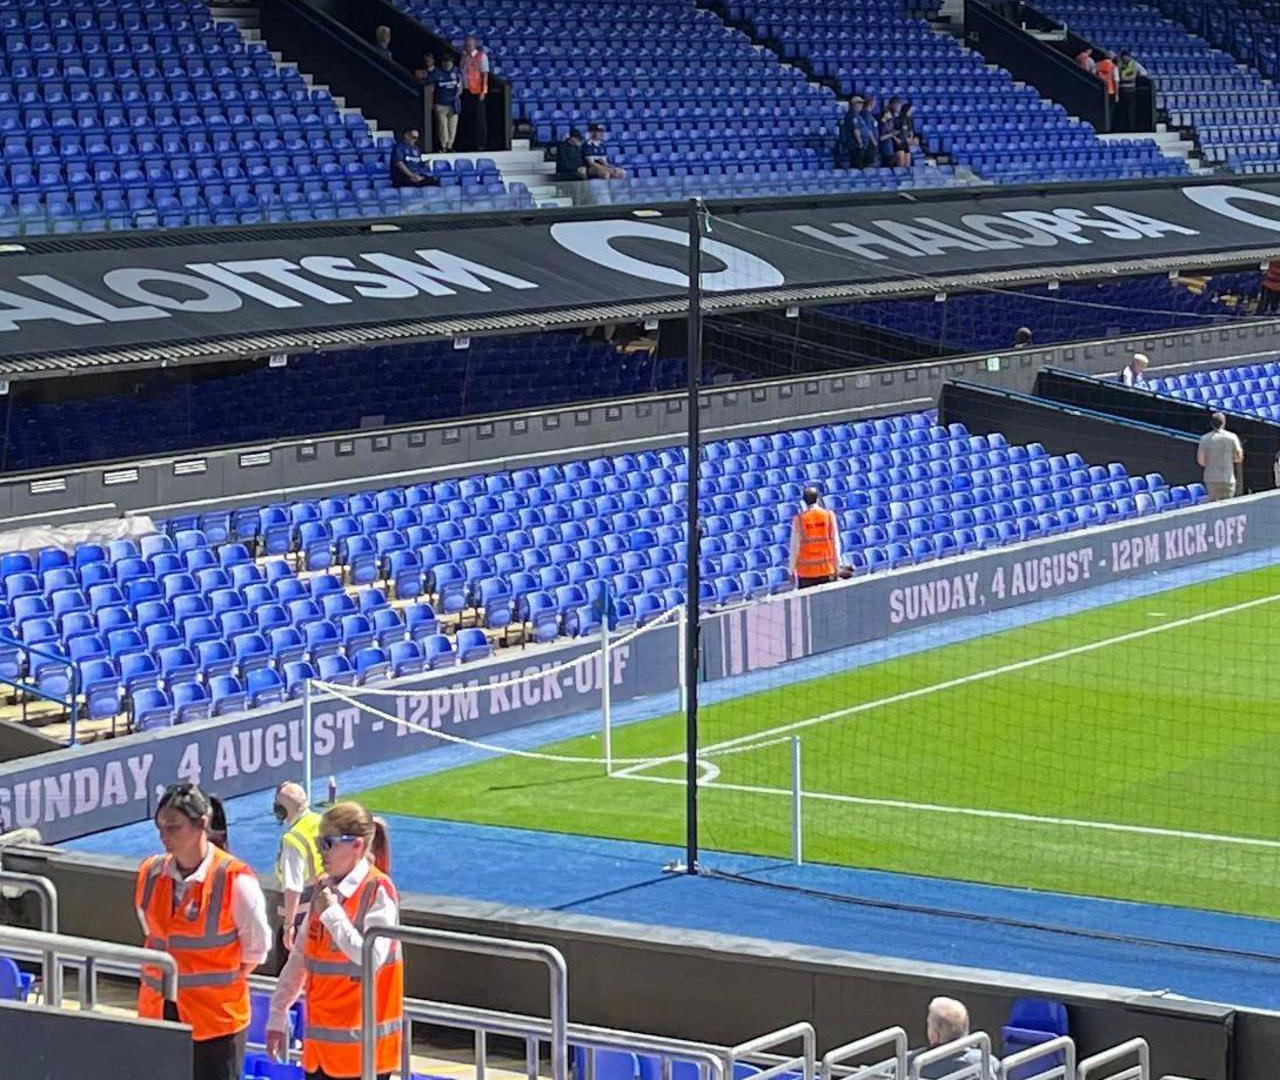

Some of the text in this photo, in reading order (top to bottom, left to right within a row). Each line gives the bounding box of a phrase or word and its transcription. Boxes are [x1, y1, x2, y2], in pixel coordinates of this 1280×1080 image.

[793, 204, 1200, 262] HALOPSA
[890, 572, 986, 623] SUNDAY,
[992, 566, 1006, 598] 4
[1011, 549, 1094, 596] AUGUST
[1111, 532, 1160, 574] 12PM
[1165, 514, 1248, 564] KICK-OFF
[177, 747, 202, 787] 4
[214, 713, 361, 780] AUGUST
[396, 683, 479, 736] 12PM
[489, 645, 632, 716] KICK-OFF
